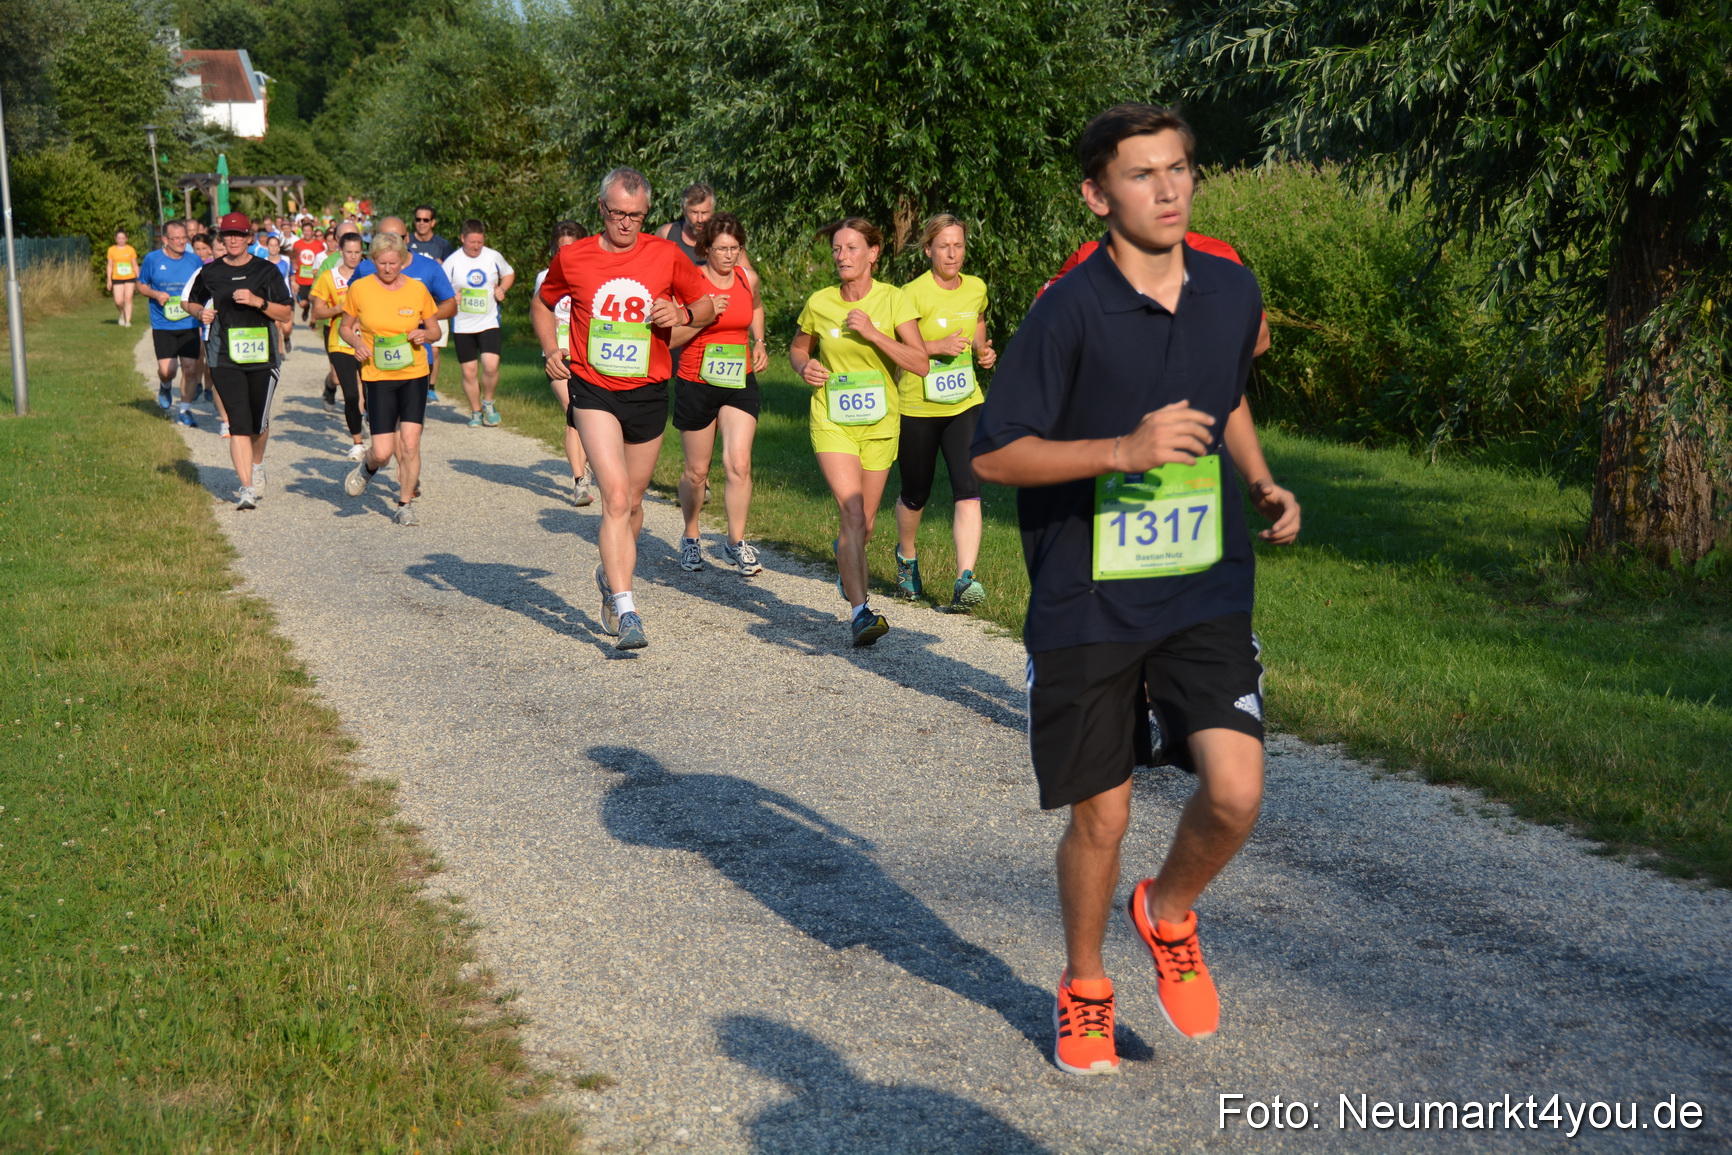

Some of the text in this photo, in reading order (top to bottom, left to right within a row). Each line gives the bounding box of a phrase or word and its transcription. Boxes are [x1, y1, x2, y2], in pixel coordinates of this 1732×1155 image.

[462, 297, 485, 308] 1486
[600, 293, 646, 323] 48
[234, 341, 265, 354] 1214
[383, 349, 402, 361] 64
[600, 343, 637, 363] 542
[707, 360, 743, 377] 1377
[935, 372, 967, 391] 666
[839, 392, 876, 411] 665
[1110, 504, 1209, 547] 1317
[1135, 551, 1184, 562] Bastian Nutz
